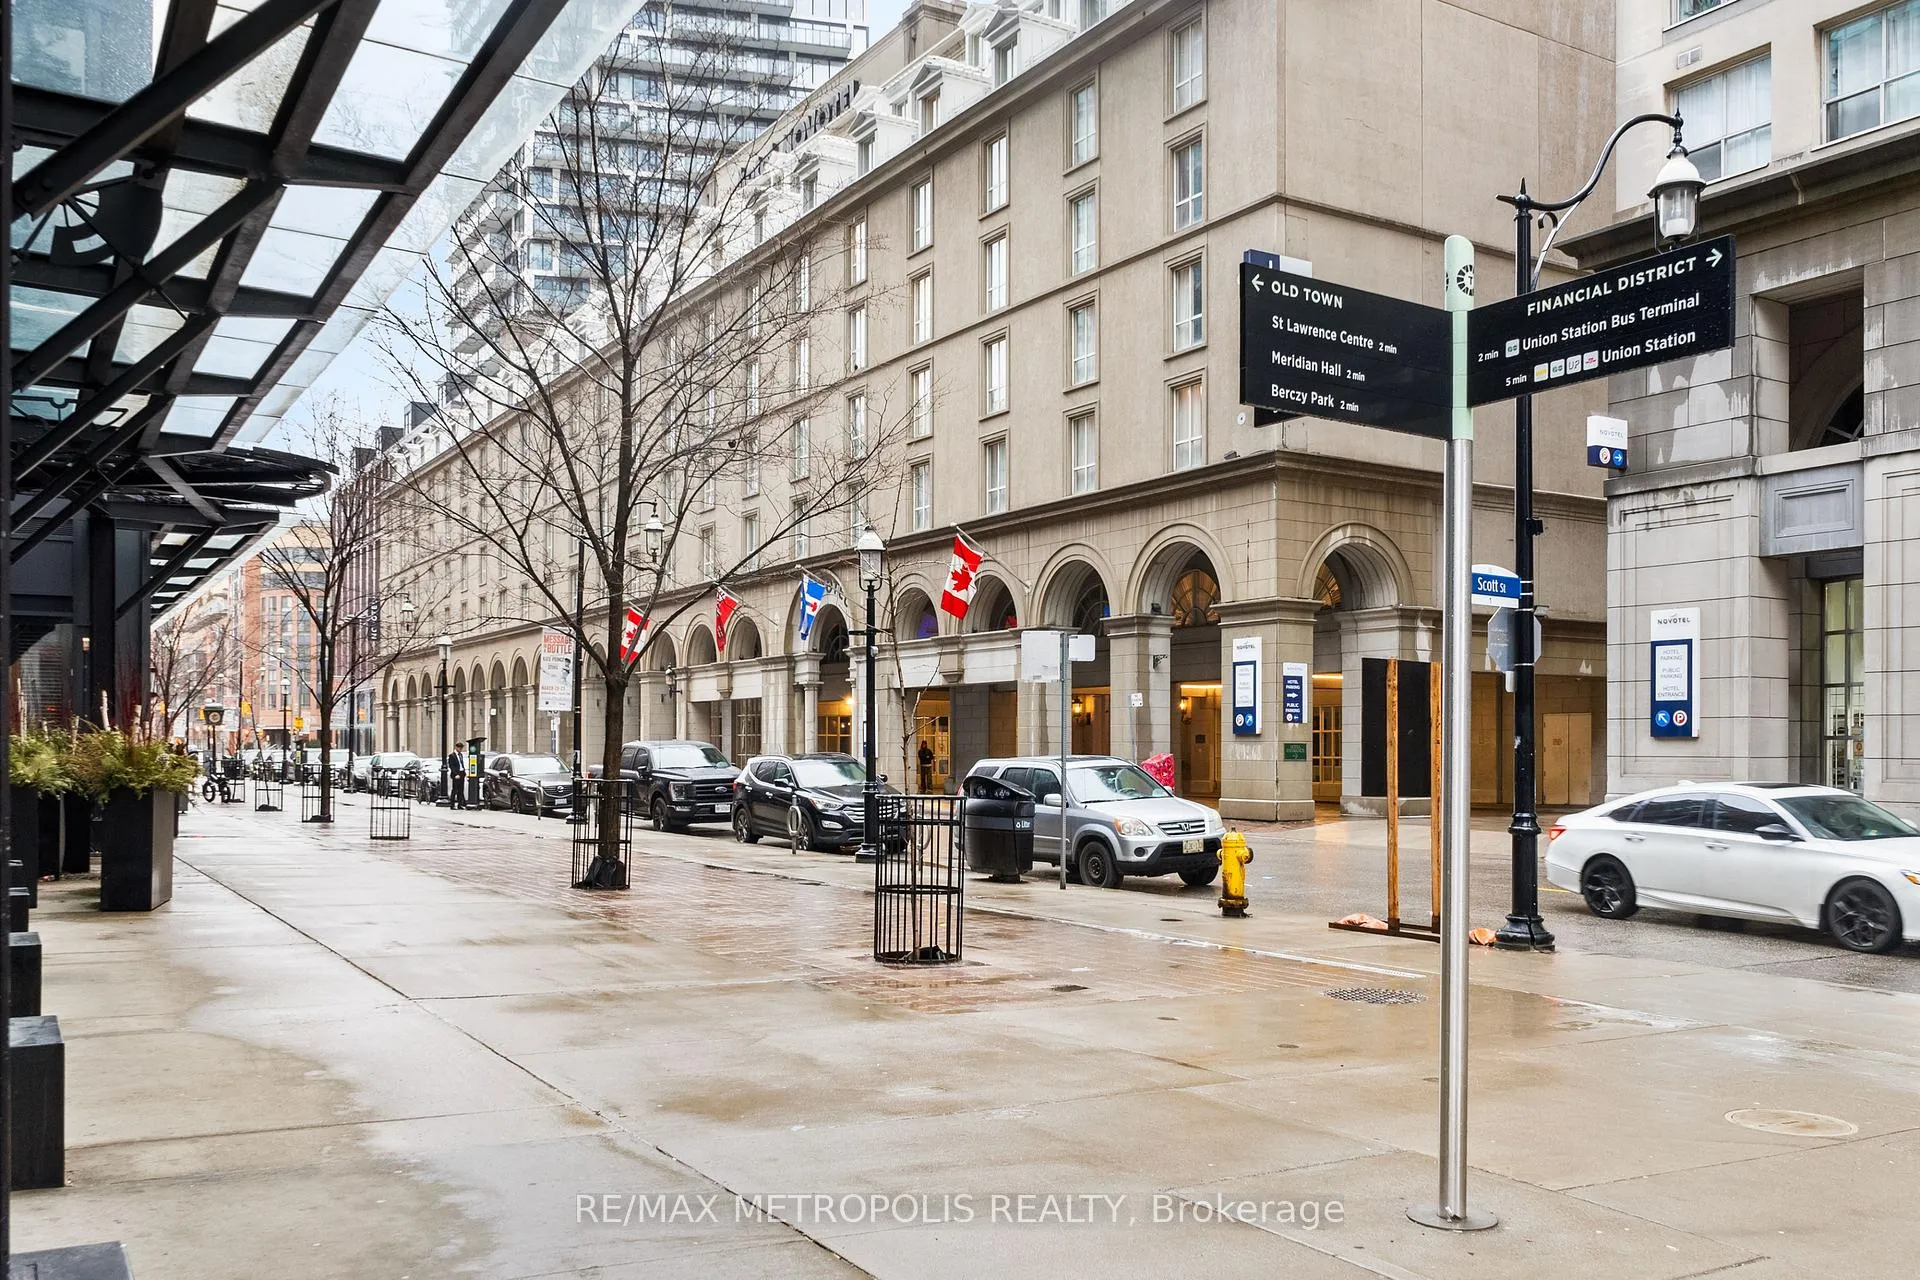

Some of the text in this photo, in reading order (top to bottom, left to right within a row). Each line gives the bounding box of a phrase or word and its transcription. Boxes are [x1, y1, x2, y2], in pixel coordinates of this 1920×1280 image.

[1271, 280, 1343, 309] OLD TOWN
[1527, 256, 1697, 317] FINANCIAL DISTRICT
[1271, 315, 1397, 354] St Lawrence Centre 2 min
[1522, 331, 1557, 351] Union
[1561, 319, 1607, 342] Station
[1611, 310, 1635, 329] Bus
[1640, 293, 1700, 321] Terminal
[1478, 348, 1499, 363] 2 min
[1602, 344, 1640, 363] Union
[1645, 330, 1696, 354] Station
[1271, 351, 1365, 382] Meridian Hall 2 min
[1505, 373, 1527, 387] 5 min
[1271, 384, 1359, 412] Berczy Park 2 min
[1477, 576, 1506, 594] Scott St
[1657, 617, 1691, 625] NOVOTEL
[547, 644, 572, 654] BOTTLE
